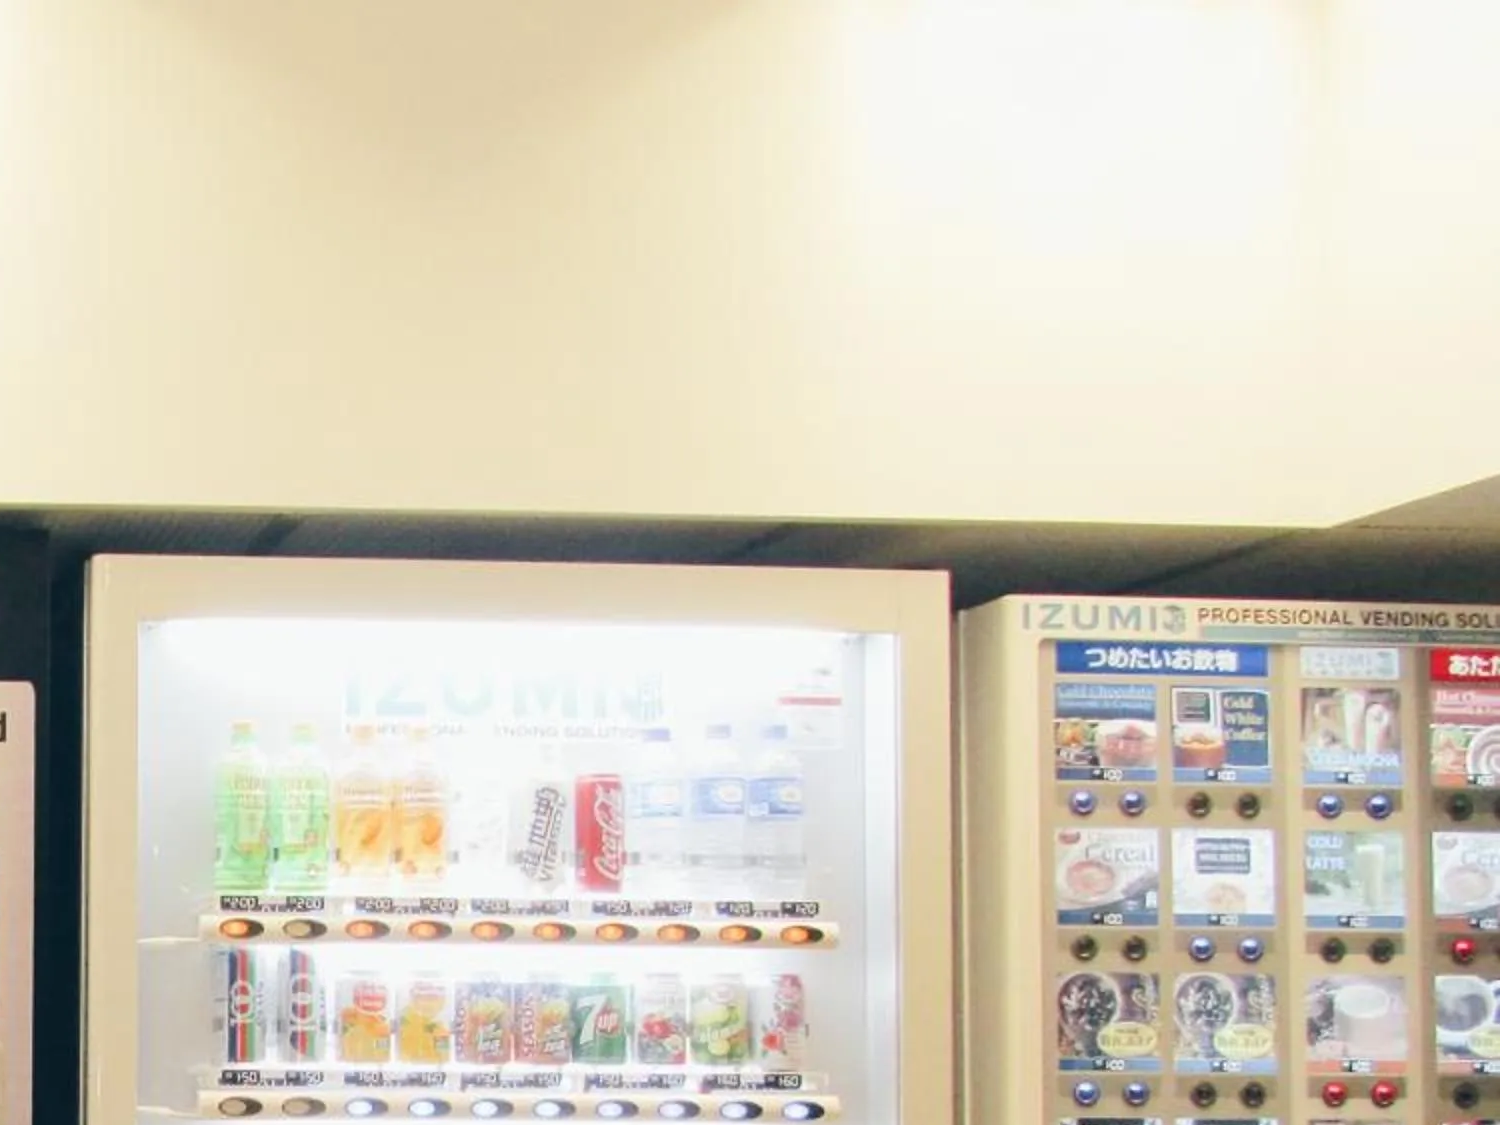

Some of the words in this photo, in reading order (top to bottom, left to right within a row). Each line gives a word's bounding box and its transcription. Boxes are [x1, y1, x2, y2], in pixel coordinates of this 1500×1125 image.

[1022, 603, 1157, 632] IZUMI
[1198, 607, 1353, 625] PROFESSIONAL
[1360, 611, 1449, 628] VENDING
